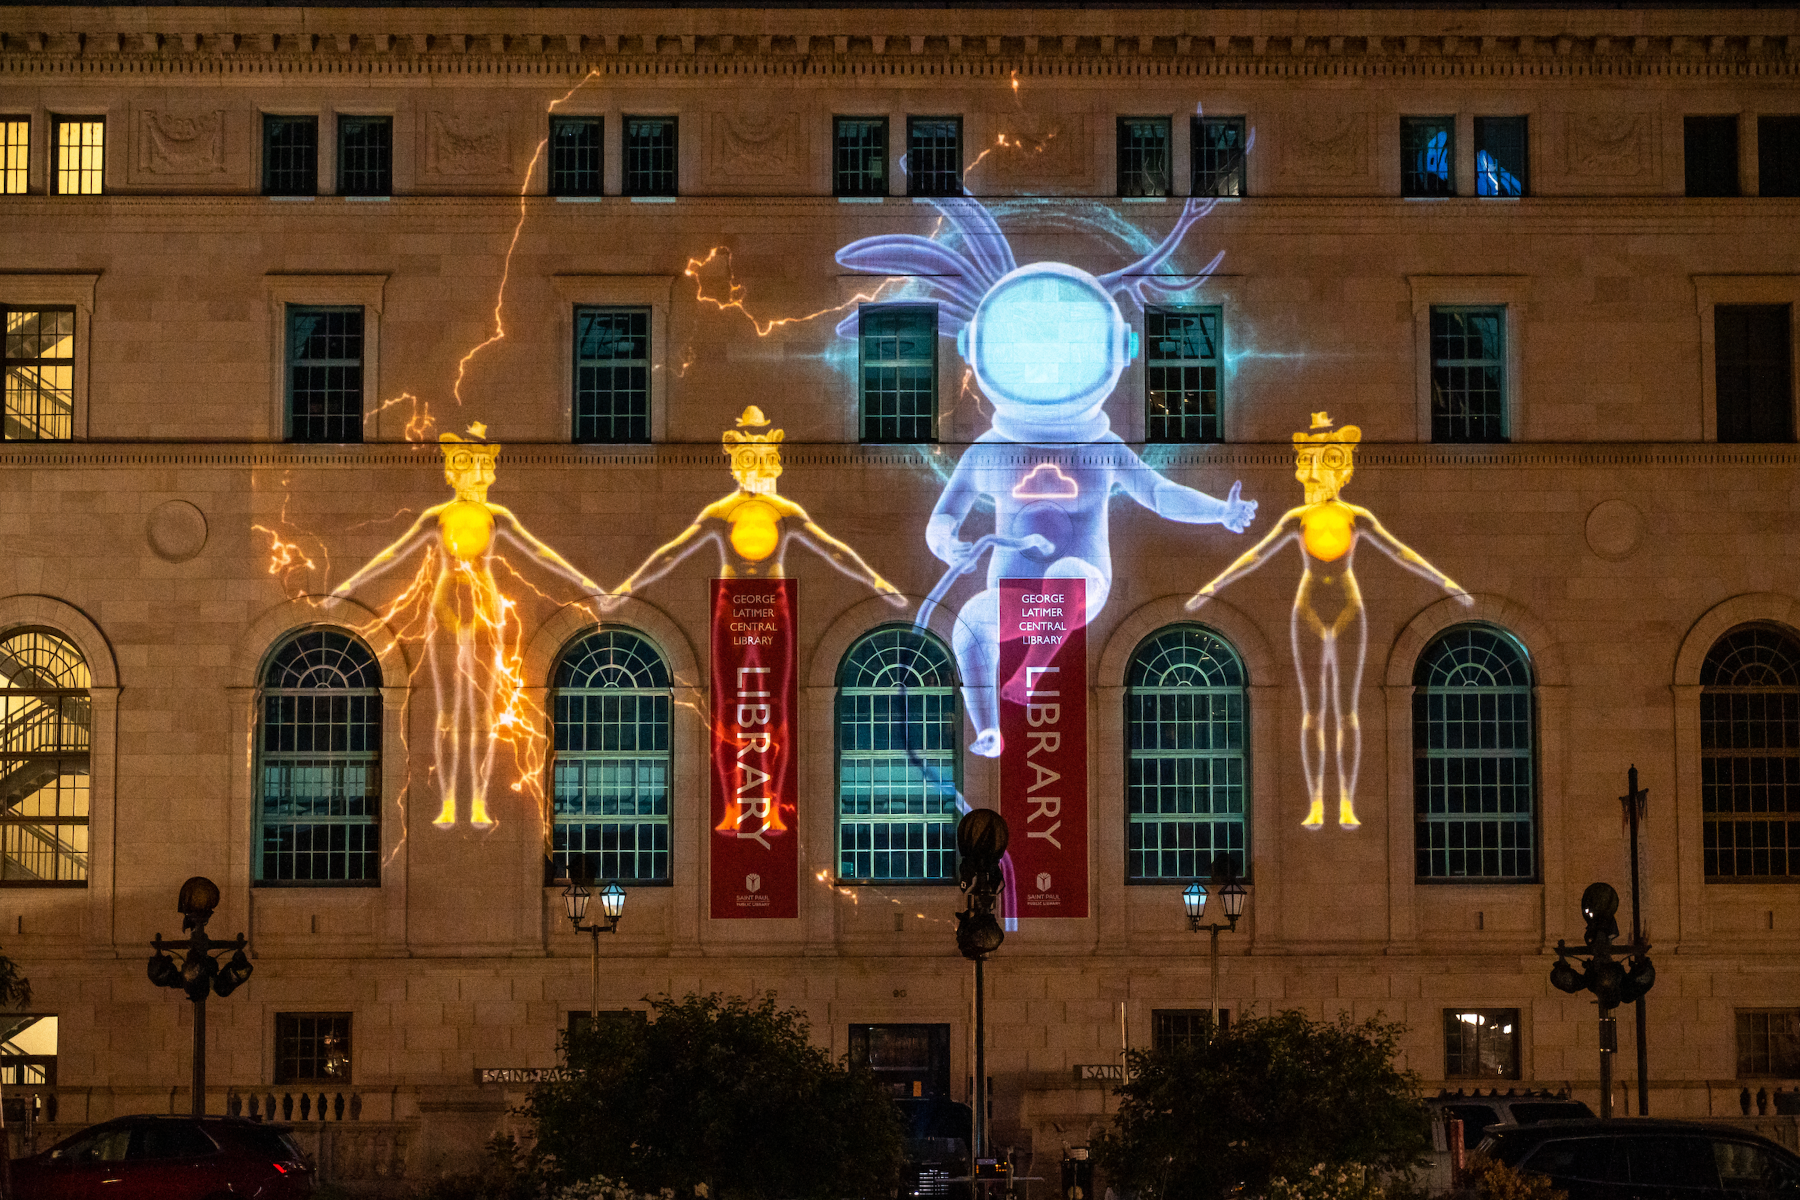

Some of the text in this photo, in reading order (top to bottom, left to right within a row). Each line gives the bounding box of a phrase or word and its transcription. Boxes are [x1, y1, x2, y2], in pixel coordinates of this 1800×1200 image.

[733, 594, 776, 604] GEORGE
[1021, 594, 1065, 603] GEORGE
[733, 608, 775, 618] LATIMER
[1021, 608, 1063, 617] LATIMER
[730, 622, 778, 632] CENTRAL
[1018, 622, 1067, 631] CENTRAL
[733, 636, 774, 645] LIBRARY
[1022, 635, 1063, 645] LIBRARY
[736, 667, 771, 850] LIBRARY
[1026, 666, 1061, 850] LIBRARY
[1087, 1066, 1123, 1079] SAIN
